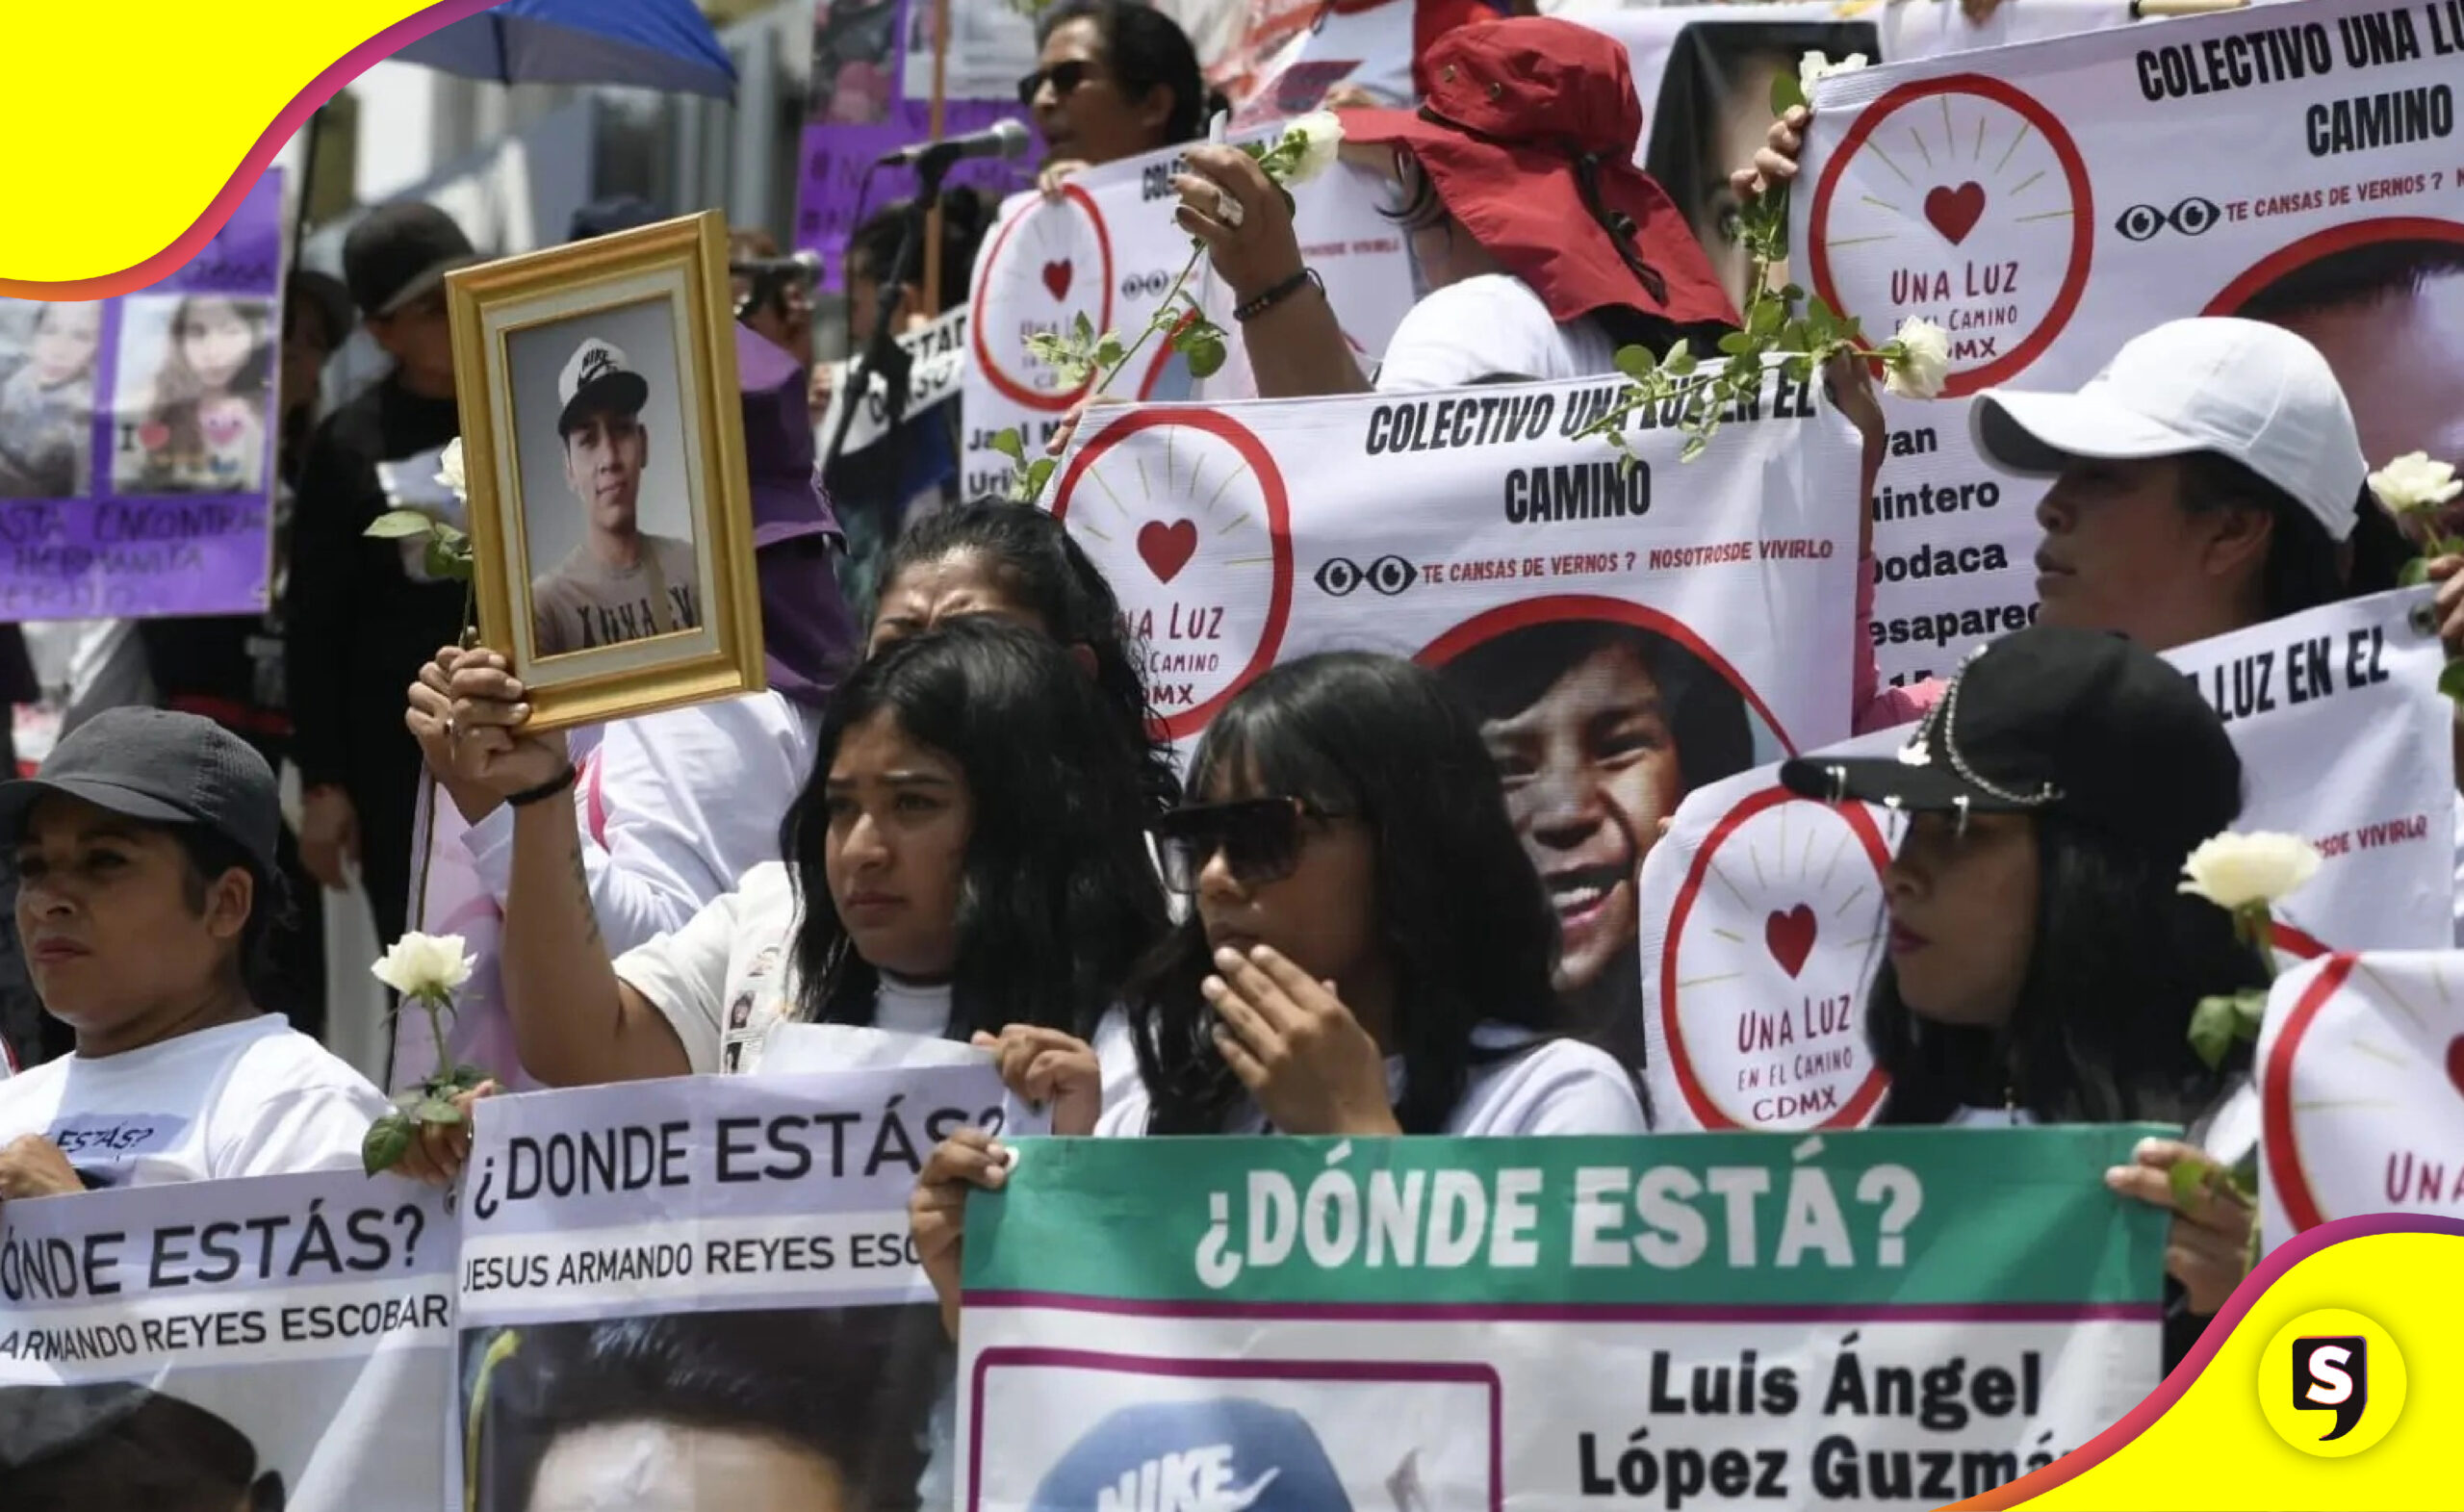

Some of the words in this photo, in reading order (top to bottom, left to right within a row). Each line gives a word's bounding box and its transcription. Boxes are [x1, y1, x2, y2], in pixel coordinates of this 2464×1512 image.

[2136, 22, 2332, 102] COLECTIVO
[2337, 8, 2421, 68] UNA
[2306, 84, 2452, 158] CAMINO
[2225, 201, 2248, 222] TE
[2254, 190, 2323, 218] CANSAS
[2328, 186, 2350, 206] DE
[2356, 173, 2426, 202] VERNOS
[1891, 268, 1950, 305] UNA
[1966, 260, 2018, 297] LUZ
[1949, 304, 2017, 331] CAMINO
[1366, 393, 1554, 455] COLECTIVO
[1504, 460, 1652, 524] CAMINO
[1422, 565, 1443, 583] TE
[1450, 558, 1516, 581] CANSAS
[1523, 557, 1544, 577] DE
[1551, 551, 1619, 577] VERNOS
[1758, 539, 1834, 558] VIVIRLO
[1170, 602, 1223, 640] LUZ
[1150, 650, 1219, 674] CAMINO
[2215, 651, 2275, 721] LUZ
[2287, 635, 2333, 705] EN
[2346, 626, 2389, 690] EL
[1738, 1010, 1793, 1054] UNA
[1804, 993, 1851, 1039] LUZ
[1738, 1069, 1759, 1091] EN
[1769, 1064, 1786, 1087] EL
[1794, 1045, 1853, 1081] CAMINO
[1753, 1085, 1836, 1121] CDMX
[474, 1120, 691, 1219] ¿DONDE
[1195, 1141, 1542, 1289] ¿DÓNDE
[1570, 1136, 1924, 1269] ESTÁ?
[1, 1225, 125, 1302] ÓNDE
[148, 1198, 425, 1289] ESTÁS?
[463, 1255, 549, 1293] JESUS
[556, 1242, 693, 1288] ARMANDO
[706, 1235, 834, 1275] REYES
[142, 1310, 267, 1353] REYES
[282, 1293, 449, 1342] ESCOBAR
[1649, 1349, 1799, 1416] Luis
[1822, 1330, 2040, 1432] Ángel
[1578, 1426, 1788, 1510] López
